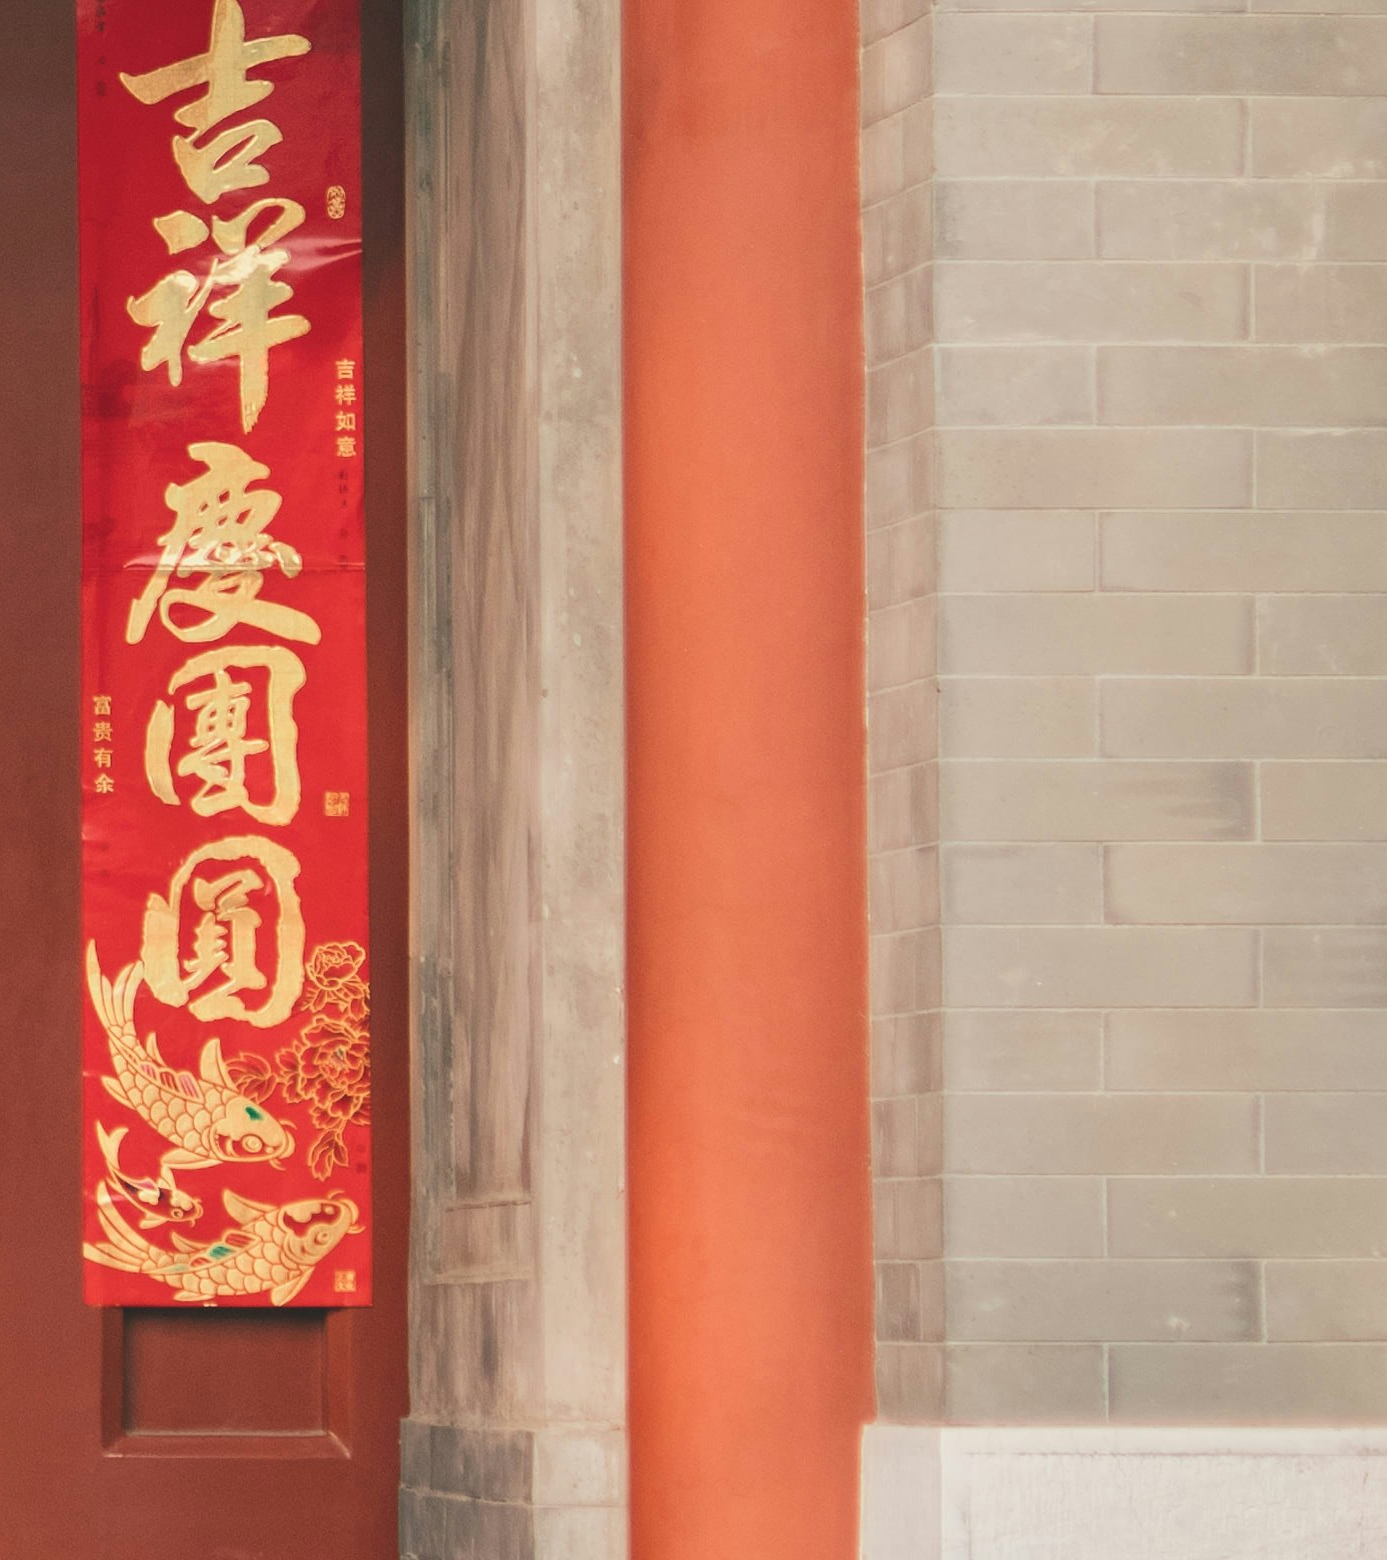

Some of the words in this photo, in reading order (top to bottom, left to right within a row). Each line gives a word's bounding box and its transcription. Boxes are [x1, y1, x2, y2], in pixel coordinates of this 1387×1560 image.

[335, 359, 357, 457] 吉祥如意
[92, 695, 114, 794] 富贵有余
